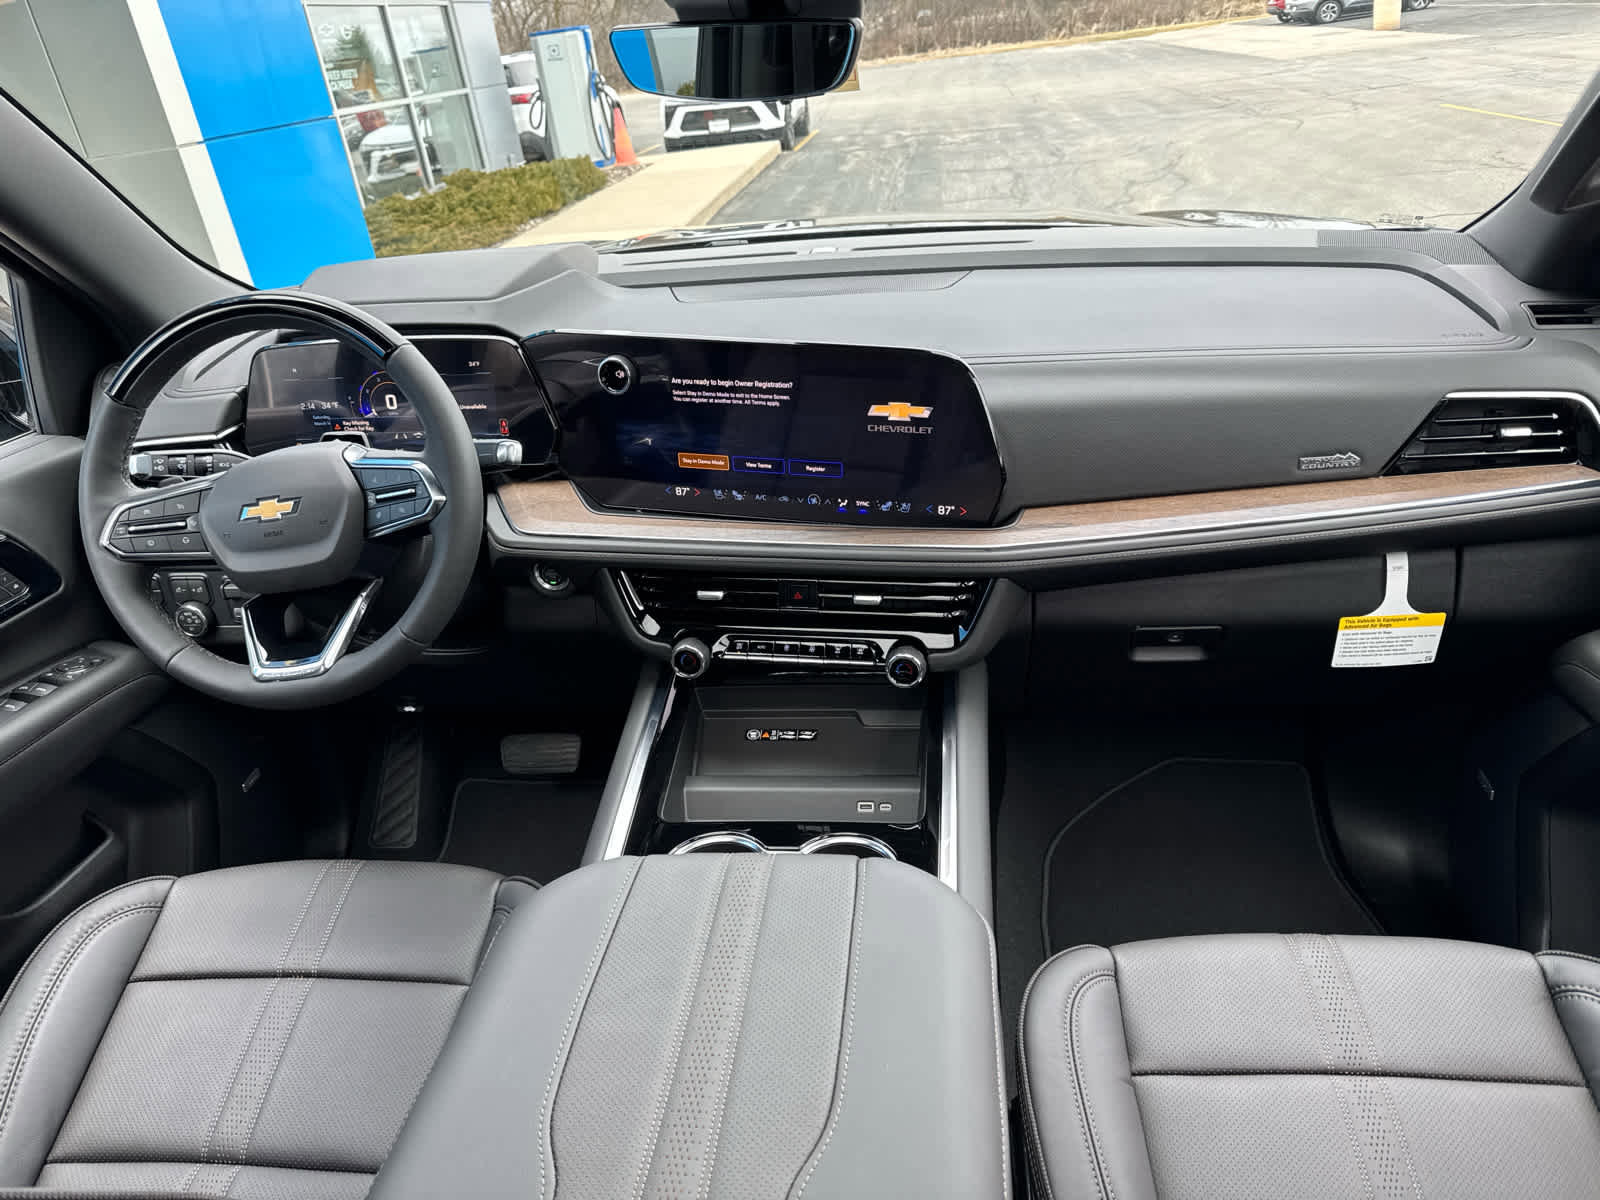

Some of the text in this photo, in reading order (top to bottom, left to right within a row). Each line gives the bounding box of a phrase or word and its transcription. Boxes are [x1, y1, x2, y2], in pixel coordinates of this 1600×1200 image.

[694, 378, 710, 387] ready
[718, 379, 734, 388] begin
[735, 380, 754, 388] Owner
[755, 380, 793, 389] Registration?
[385, 394, 398, 410] 0
[867, 424, 934, 434] CHEVROLET
[805, 465, 826, 473] Register
[675, 487, 690, 496] 87°
[755, 493, 767, 501] A/C
[937, 505, 955, 515] 87°
